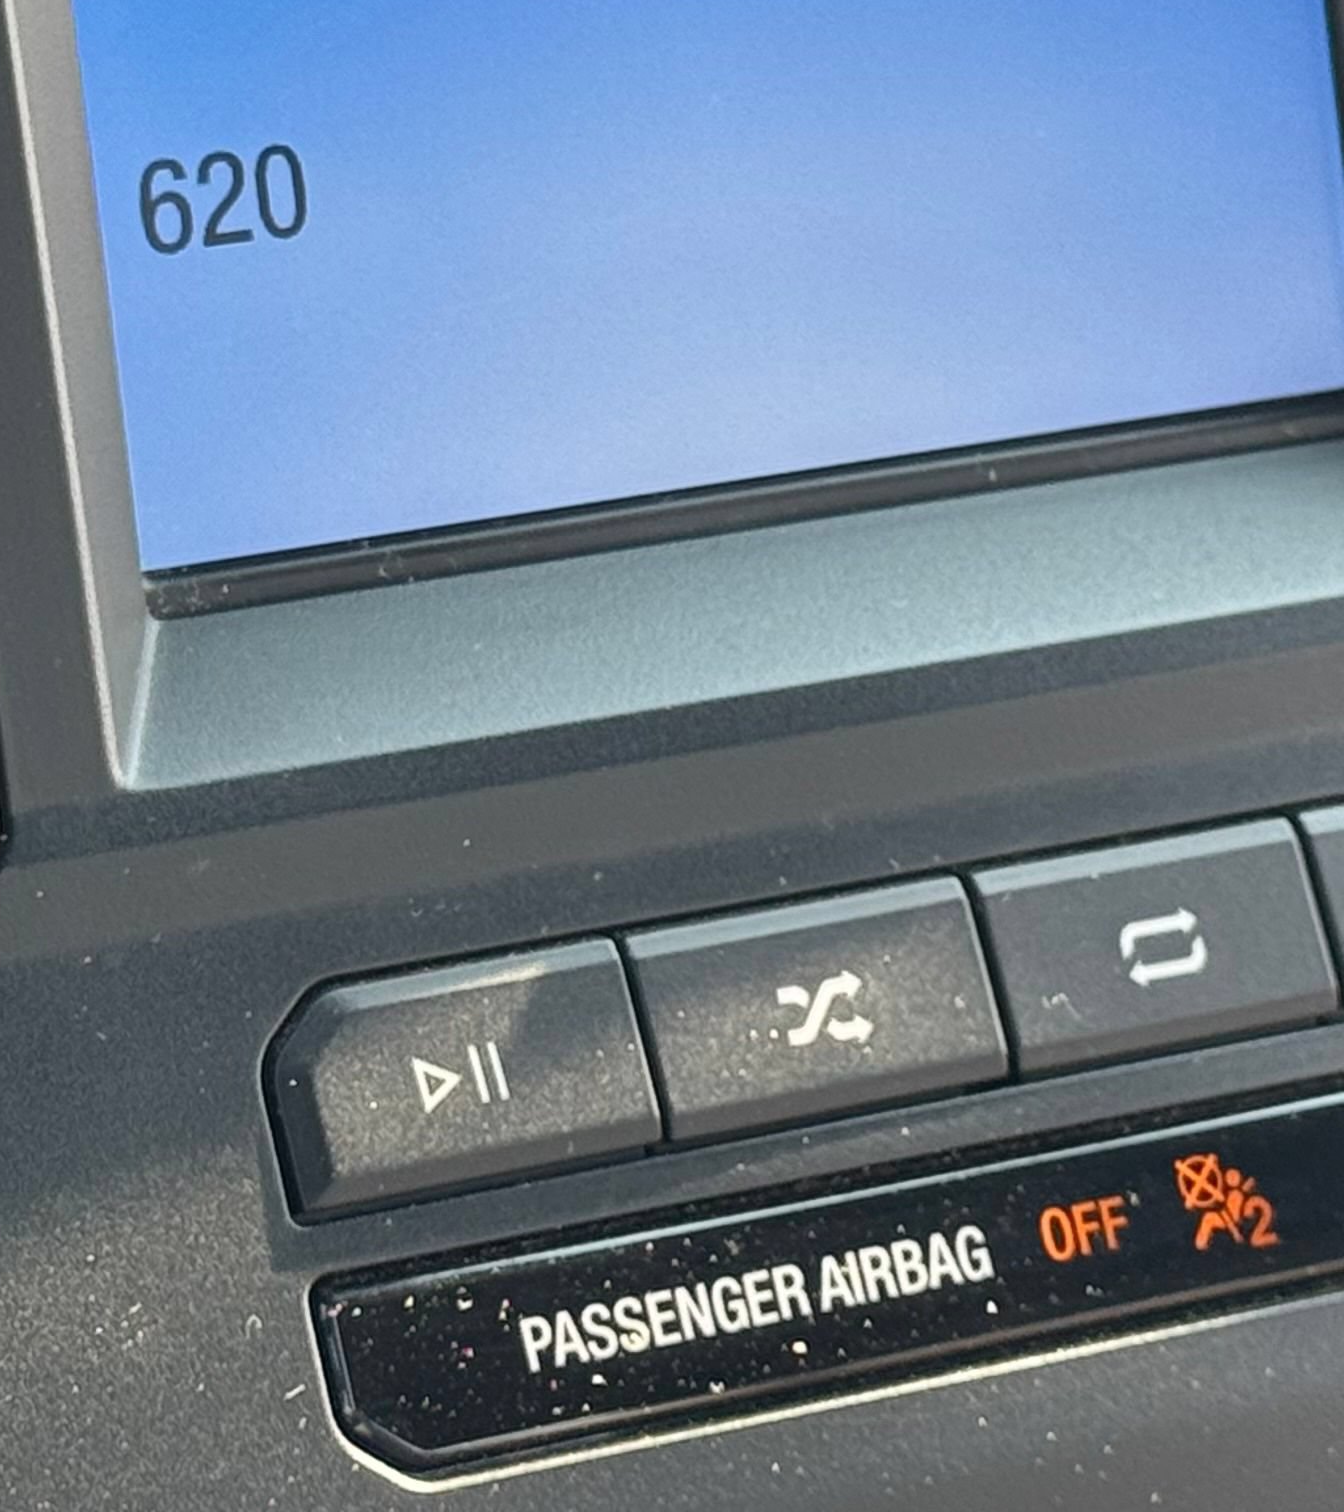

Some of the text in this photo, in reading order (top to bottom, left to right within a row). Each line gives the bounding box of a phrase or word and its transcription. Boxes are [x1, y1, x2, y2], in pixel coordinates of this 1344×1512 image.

[139, 144, 307, 255] 620
[518, 1196, 1130, 1372] PASSENGER AIRBAG OFF
